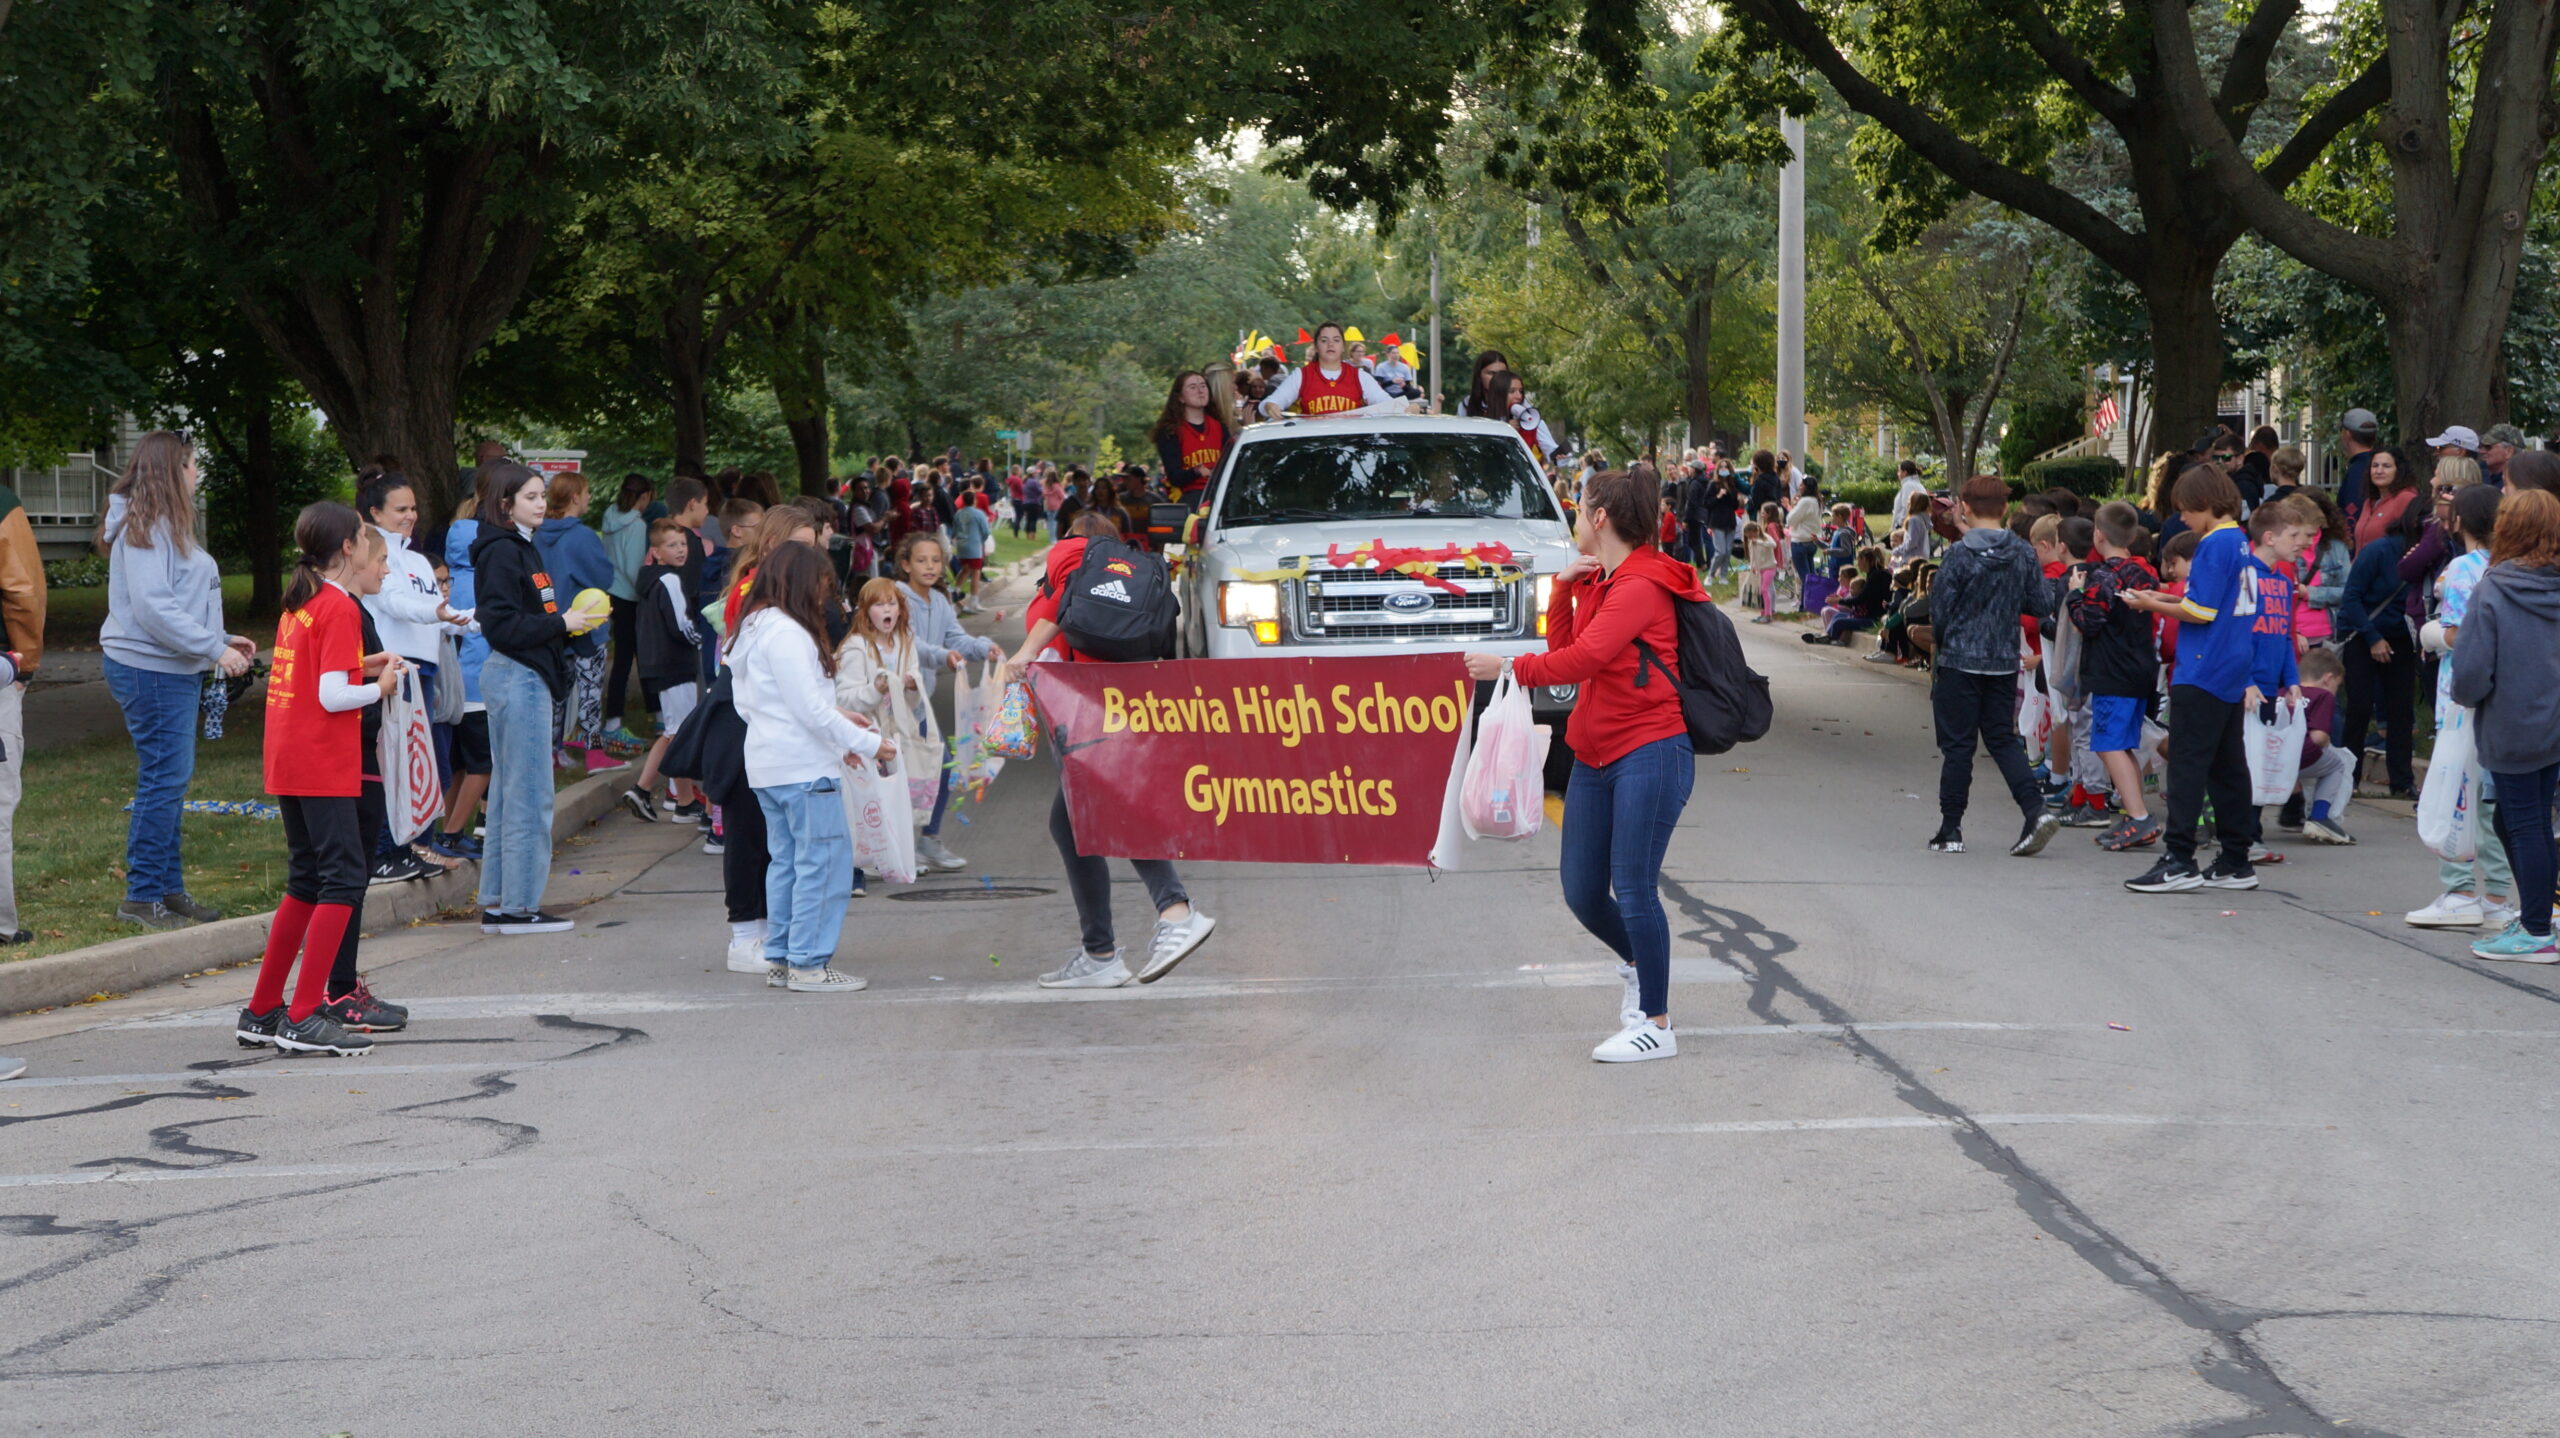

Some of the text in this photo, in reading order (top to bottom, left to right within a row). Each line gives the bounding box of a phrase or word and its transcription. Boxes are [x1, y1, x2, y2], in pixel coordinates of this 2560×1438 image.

[1183, 448, 1220, 469] BATAVI
[407, 573, 438, 596] FILA
[1090, 587, 1131, 603] adidas
[1395, 595, 1422, 606] Ford
[2264, 596, 2288, 616] BAL
[2252, 615, 2288, 635] ANC
[1102, 679, 1468, 748] Batavia High School
[1183, 764, 1398, 827] Gymnastics
